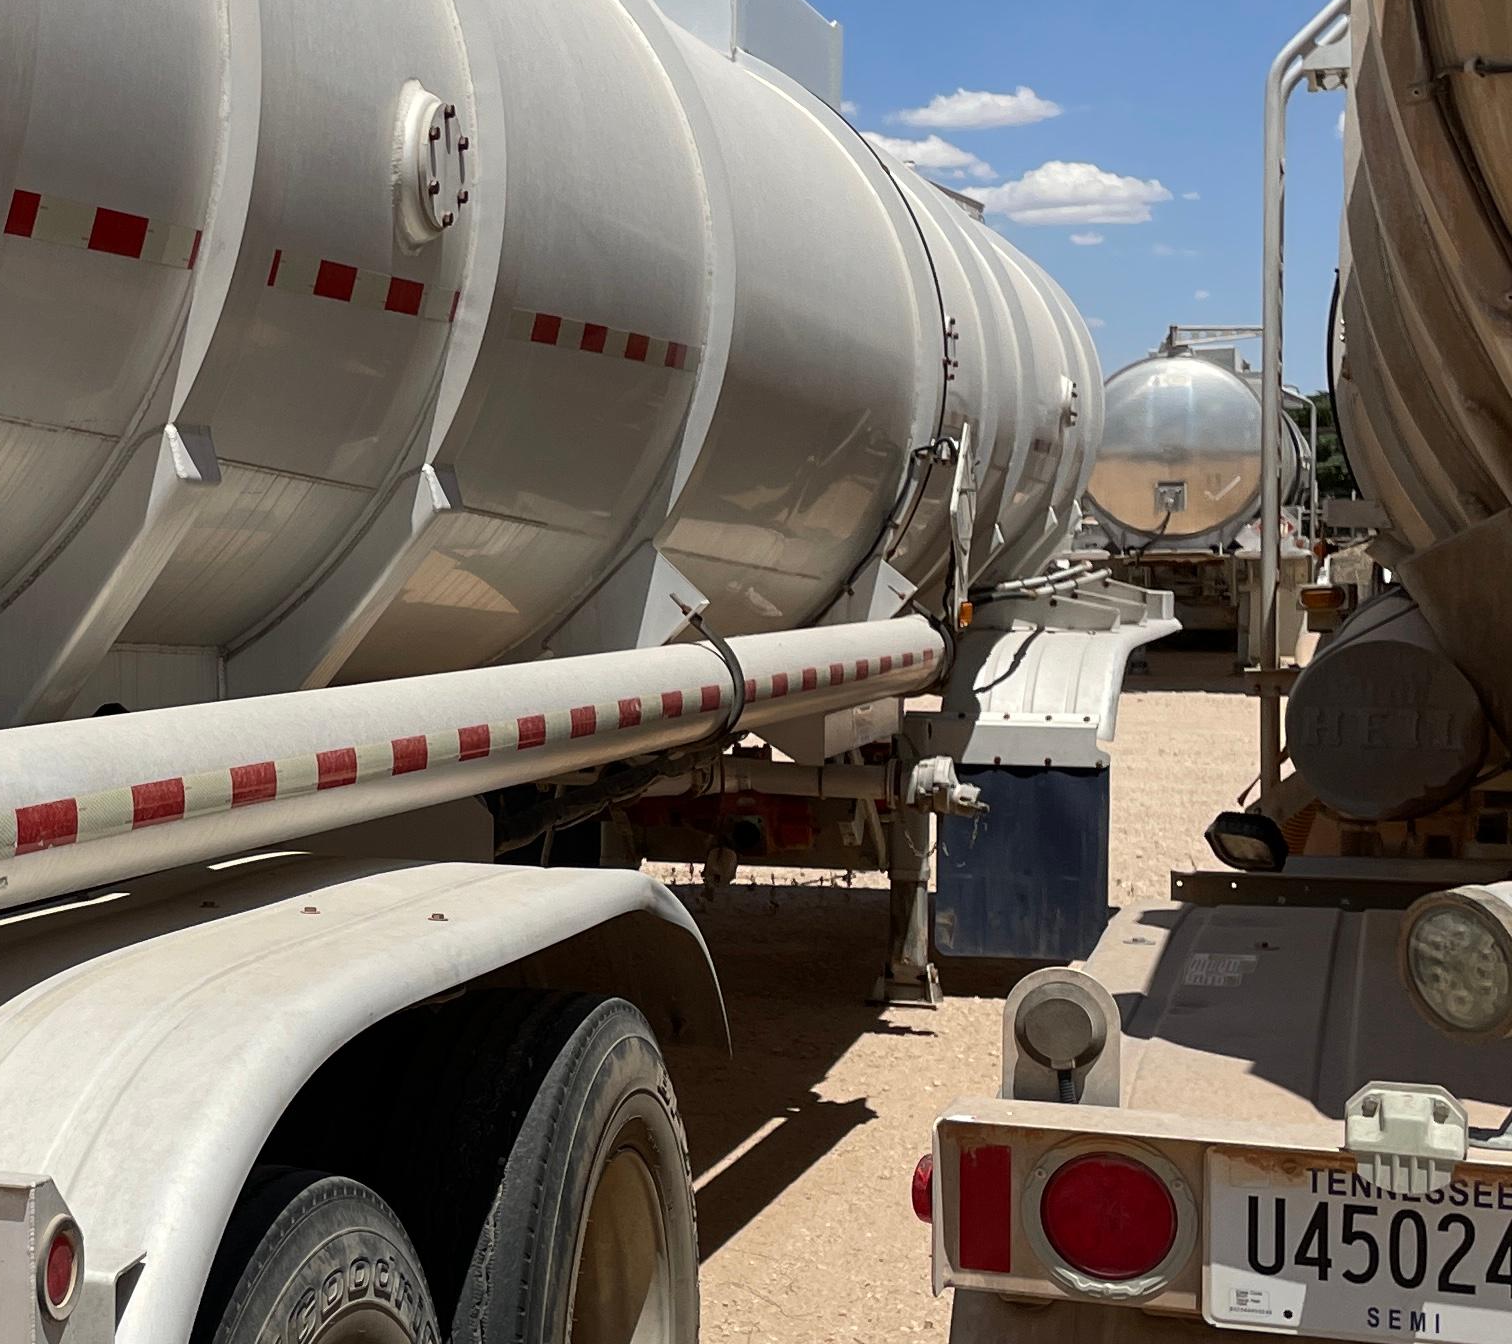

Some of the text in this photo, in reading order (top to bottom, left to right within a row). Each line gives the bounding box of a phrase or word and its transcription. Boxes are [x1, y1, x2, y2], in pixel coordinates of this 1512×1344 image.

[1305, 1167, 1512, 1210] TENSEE
[1247, 1195, 1512, 1299] U45024
[1367, 1307, 1441, 1334] SEMI
